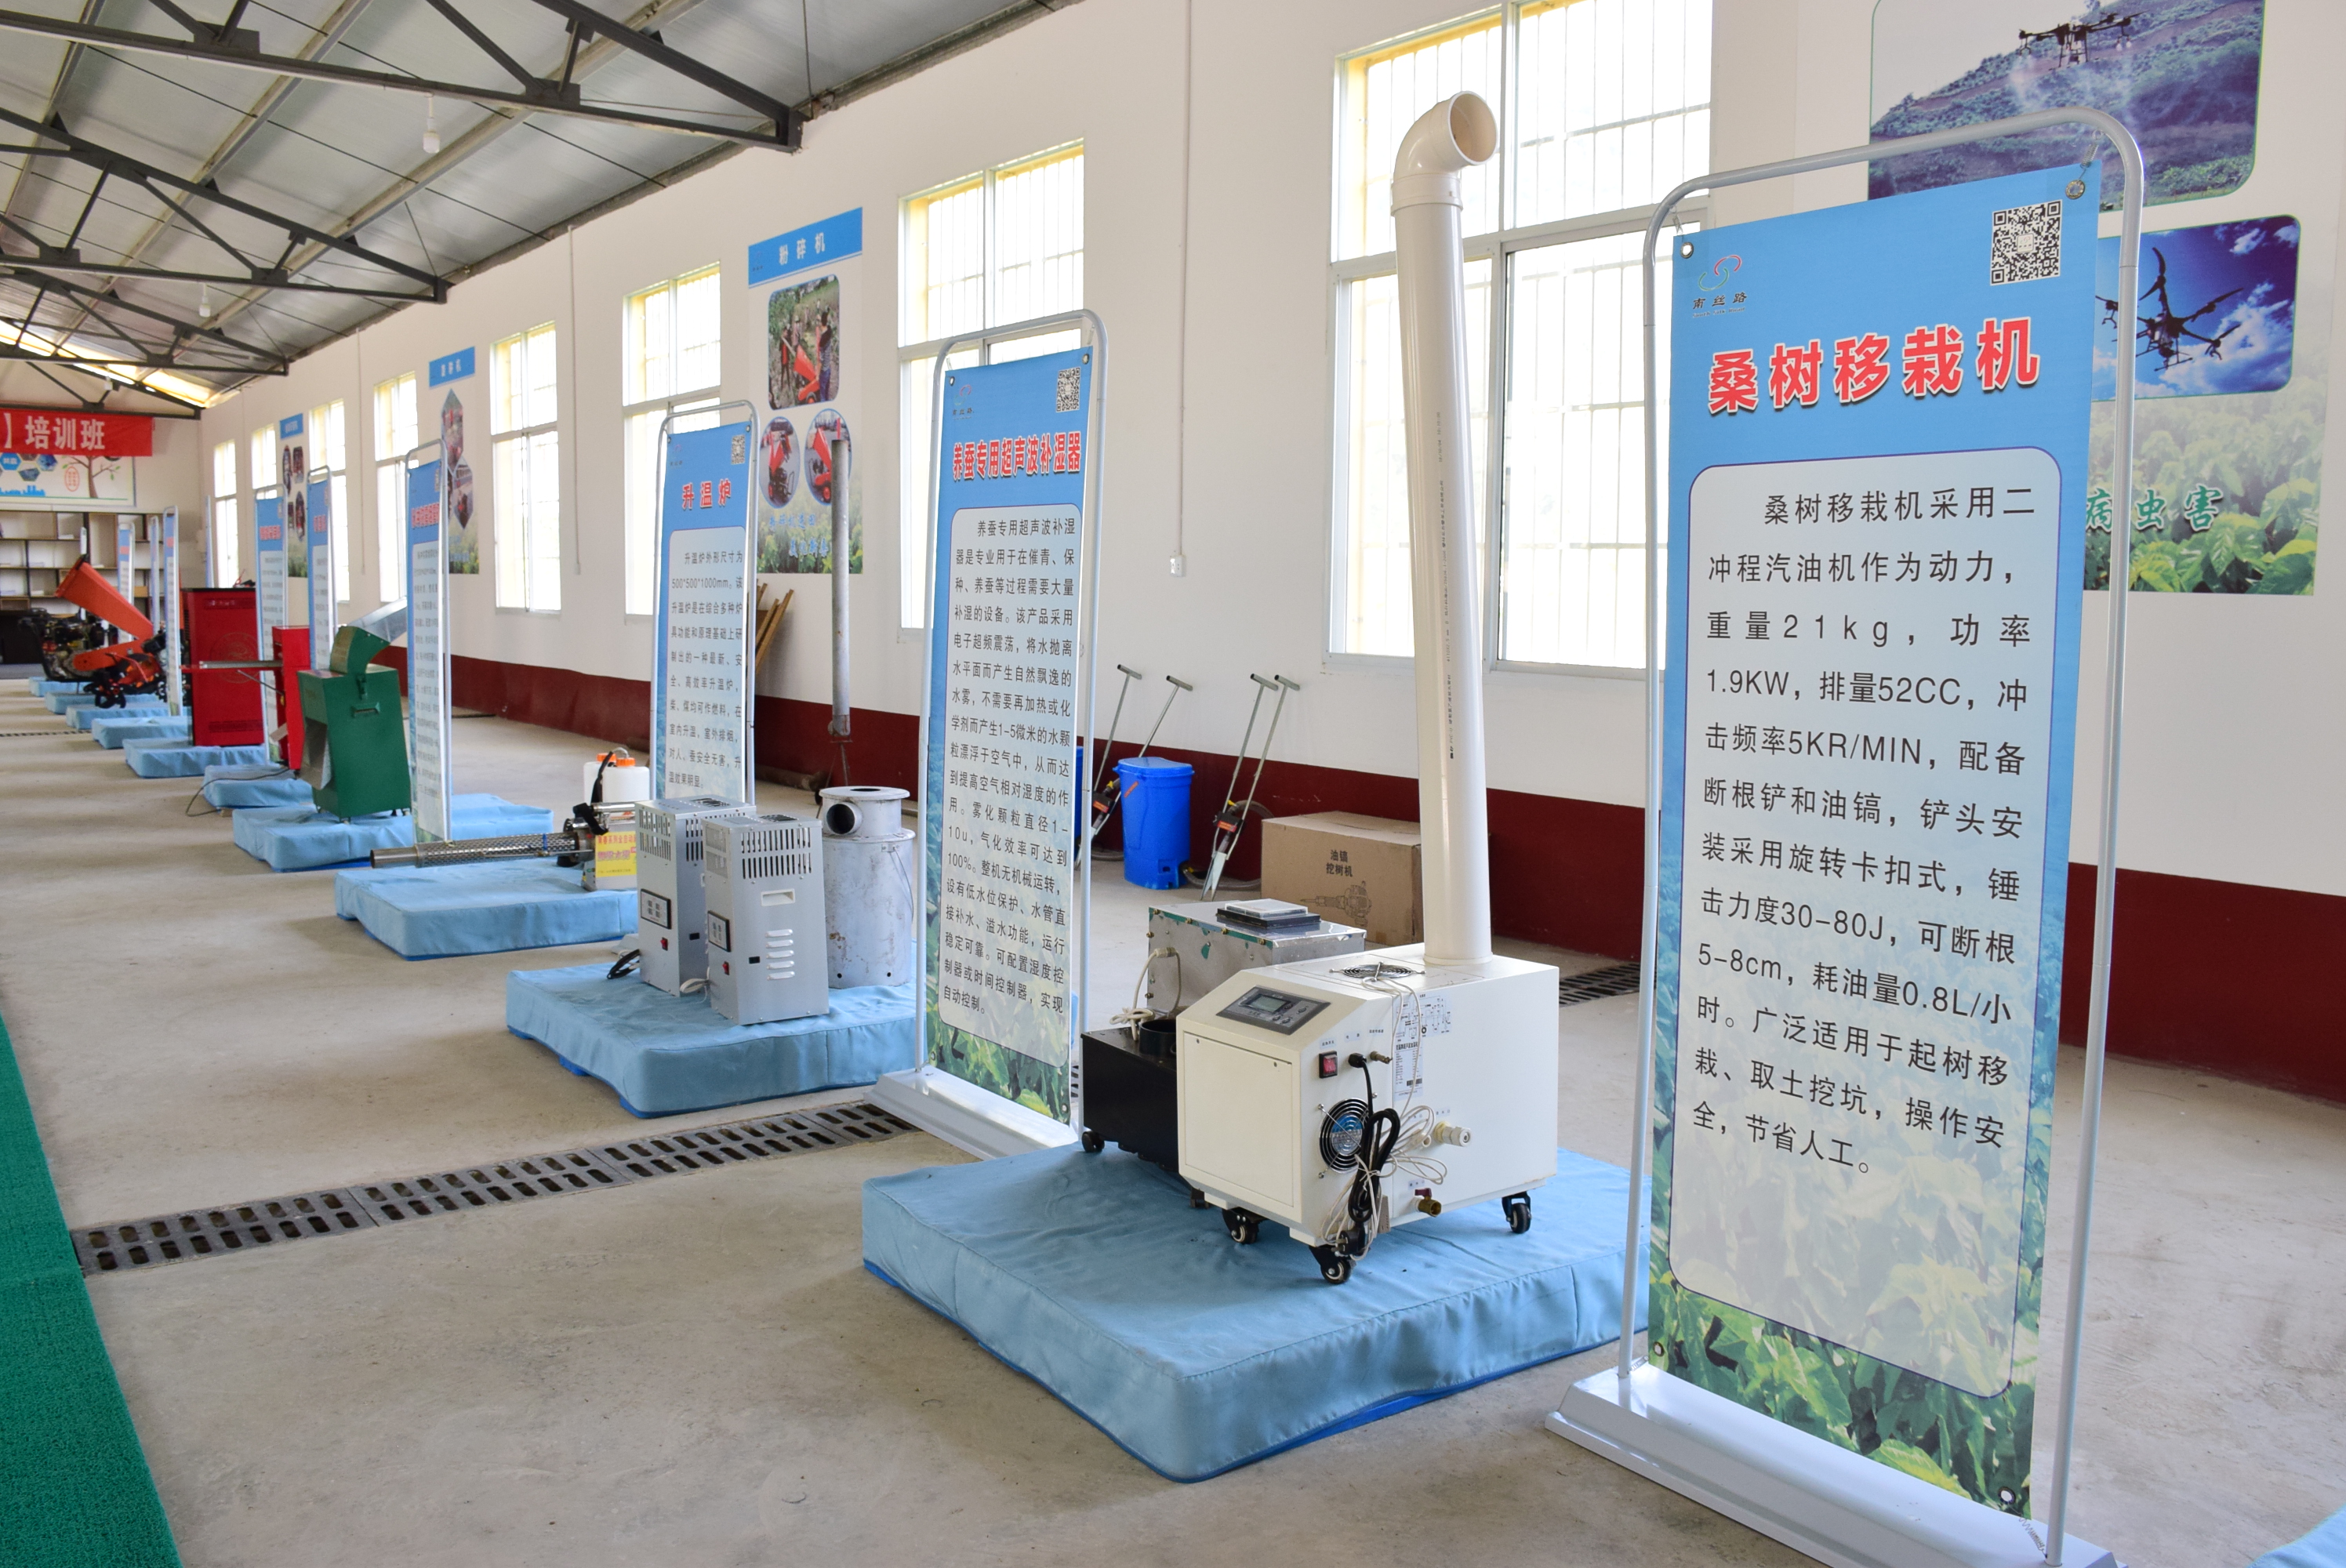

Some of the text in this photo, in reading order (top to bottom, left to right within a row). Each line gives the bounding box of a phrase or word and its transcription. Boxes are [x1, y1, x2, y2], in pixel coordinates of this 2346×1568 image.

[1692, 292, 1748, 310] 南丝路
[1709, 318, 2040, 416] 桑树移栽机
[952, 430, 1082, 481] 养蚕专用超声波补湿器
[681, 478, 732, 510] 升温炉
[1764, 487, 2036, 525] 桑树移栽机采用二
[2086, 482, 2224, 532] 病虫害
[977, 518, 1076, 537] 养蚕专用超声波补湿
[956, 548, 1074, 565] 器是专业用于在催青、保
[1708, 550, 2014, 584] 冲程汽油机作为动力，
[955, 577, 1074, 597] 种、养蚕等过程需要大量
[954, 604, 1073, 626] 补湿的设备。该产品采用
[953, 632, 1073, 657] 电子超频震荡，将水抛离
[953, 660, 1072, 687] 水平面而产生自然飘逸的
[952, 688, 1071, 717] 水雾，不需要再加热或化
[950, 742, 1070, 779] 粒漂浮于空气中，从而达
[1705, 721, 2026, 776] 击频率5KR/MIN，配备
[950, 770, 1069, 807] 到提高空气相对湿度的作
[1704, 777, 2023, 840] 断根铲和油镐，铲头安
[1325, 862, 1353, 877] 挖树机
[1330, 849, 1349, 863] 油镐
[1701, 832, 2021, 902] 装采用旋转卡扣式，锤
[946, 878, 1066, 927] 设有低水位保护、水管直
[946, 905, 1065, 956] 接补水、溢水功能，运行
[945, 931, 1064, 985] 稳定可靠。可配置湿度控
[943, 985, 986, 1015] 自动控制。
[944, 959, 1063, 1014] 制器或时间控制器，实现
[1697, 996, 2009, 1087] 时。广泛适用于起树移
[1694, 1047, 2005, 1149] 栽、取土挖坑，操作安
[1692, 1101, 1869, 1174] 全，节省人工。
